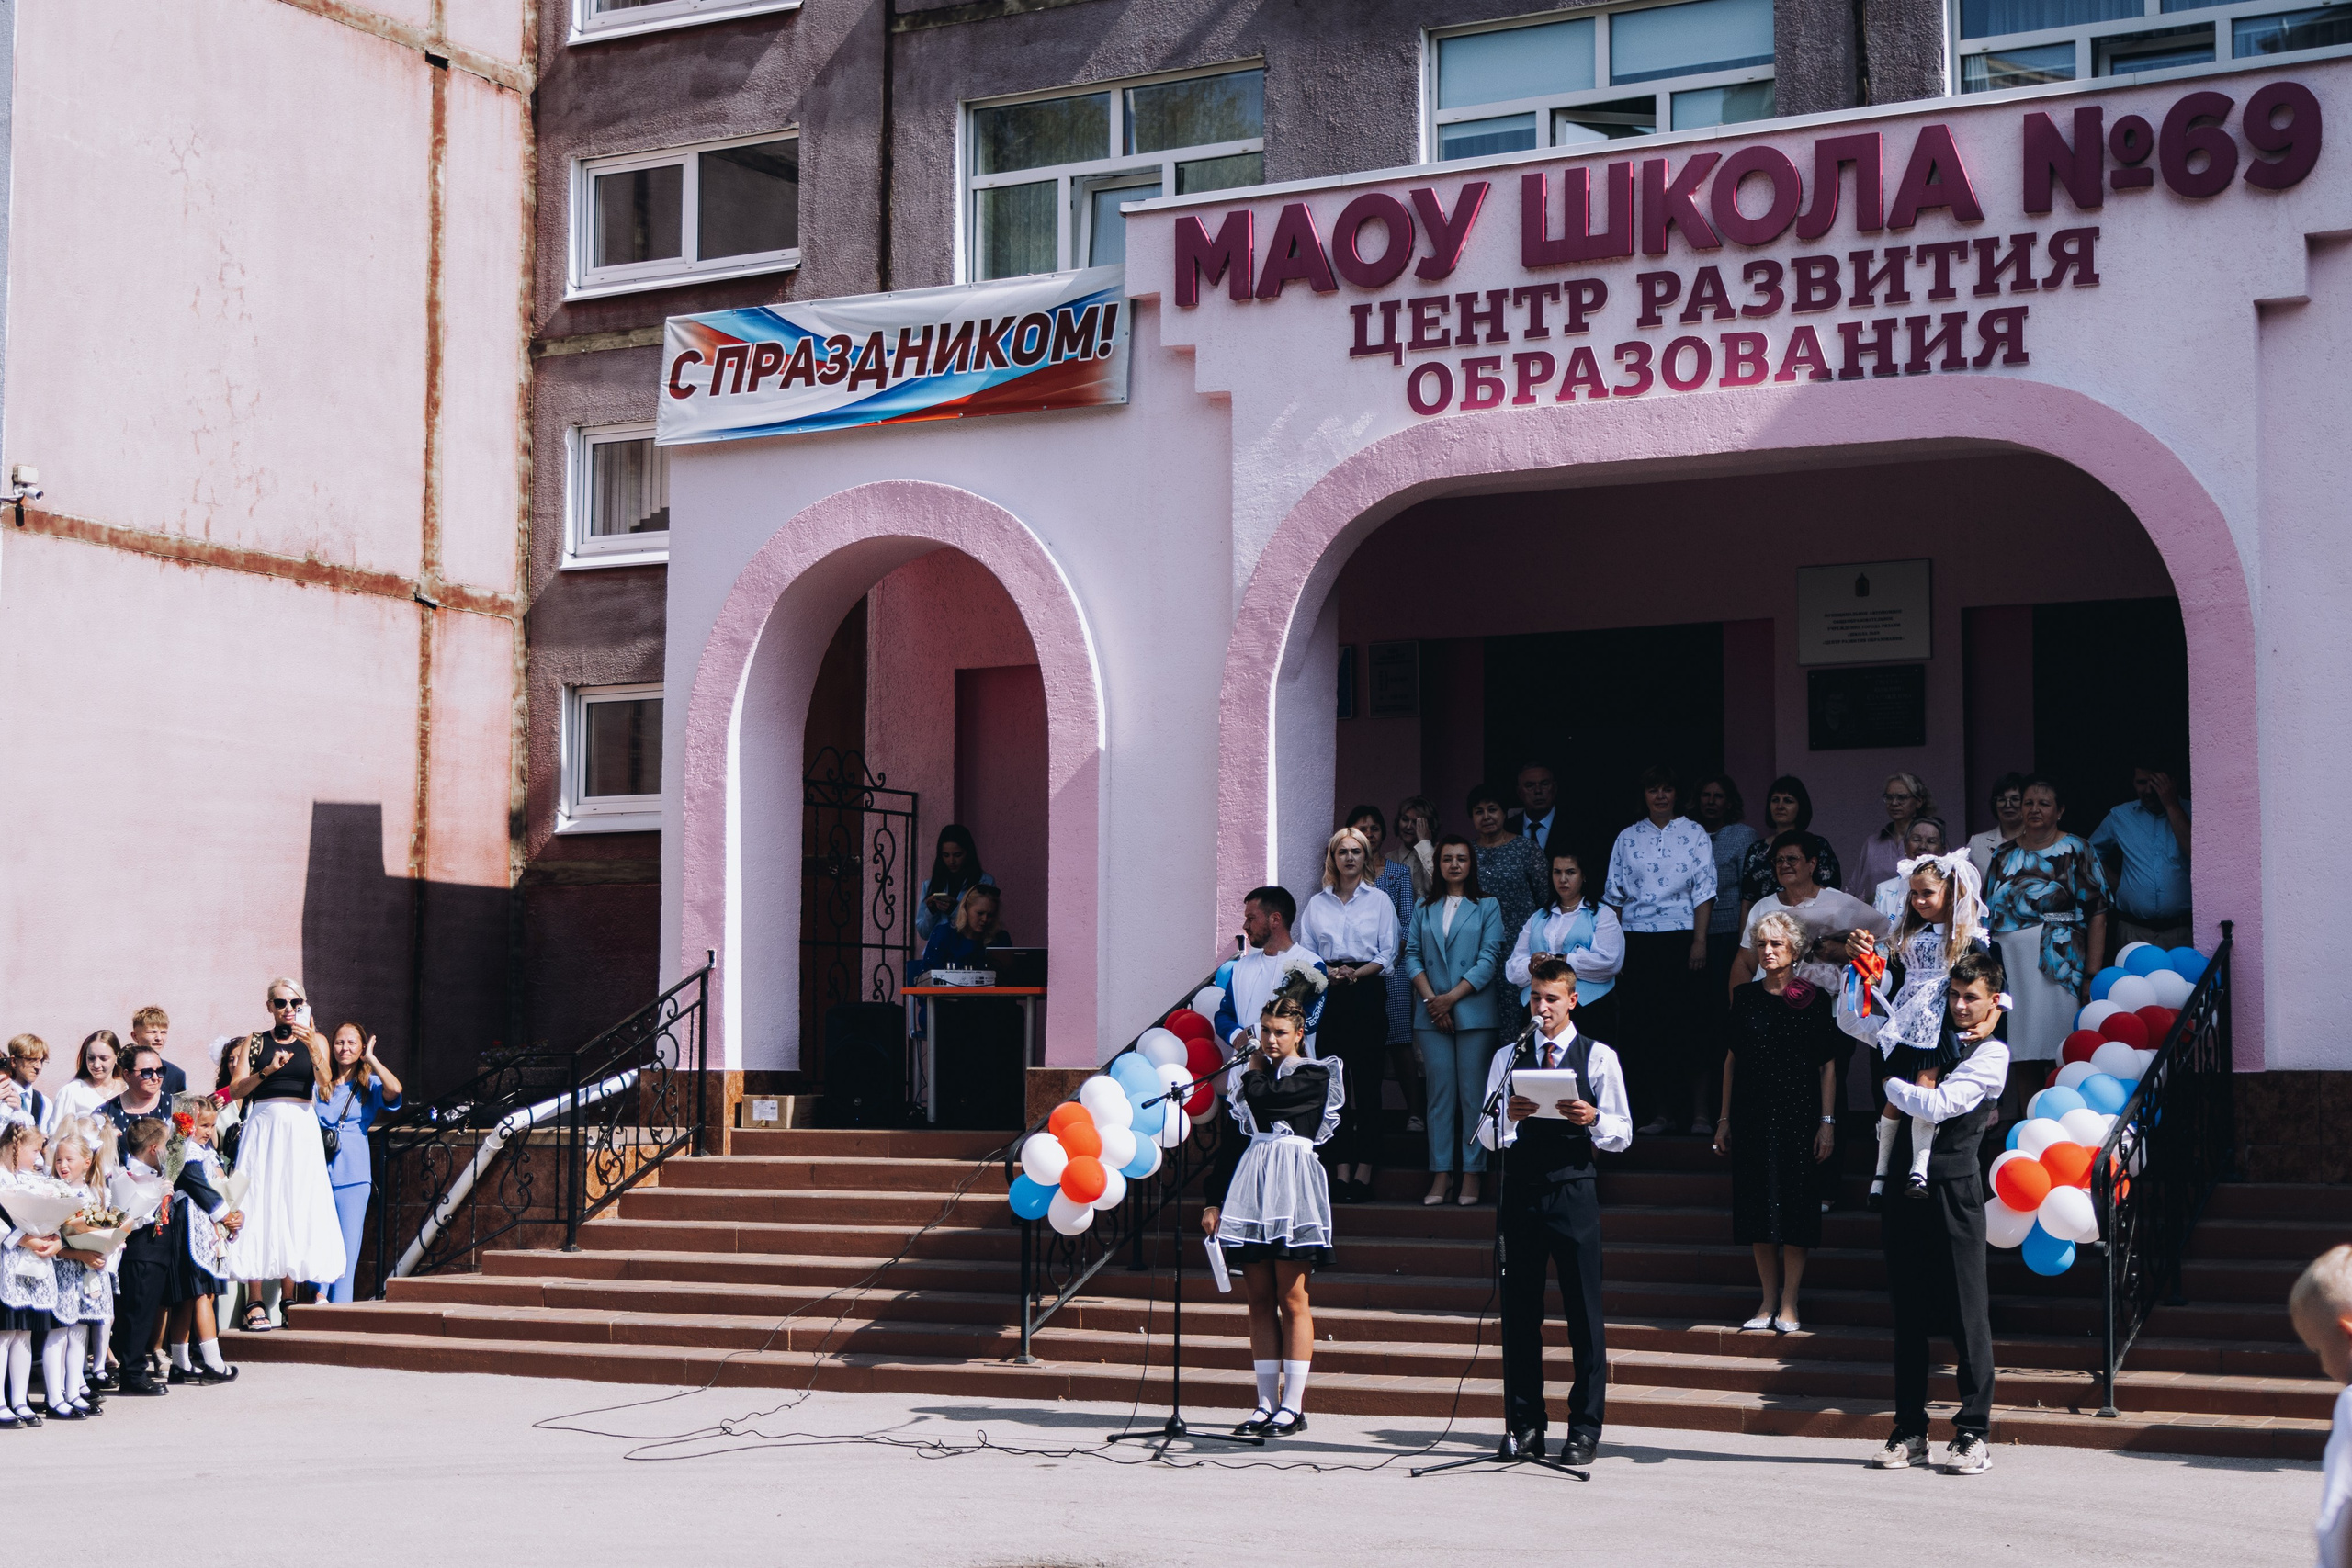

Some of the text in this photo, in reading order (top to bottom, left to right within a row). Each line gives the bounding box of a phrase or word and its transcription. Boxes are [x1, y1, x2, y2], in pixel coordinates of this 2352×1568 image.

[1175, 81, 2323, 308] МАОУ ШКОЛА №69
[668, 301, 1121, 400] С ПРАЗДНИКОМ!
[1349, 226, 2100, 367] ЦЕНТР РАЗВИТИЯ
[1407, 305, 2030, 416] ОБРАЗОВАНИЯ
